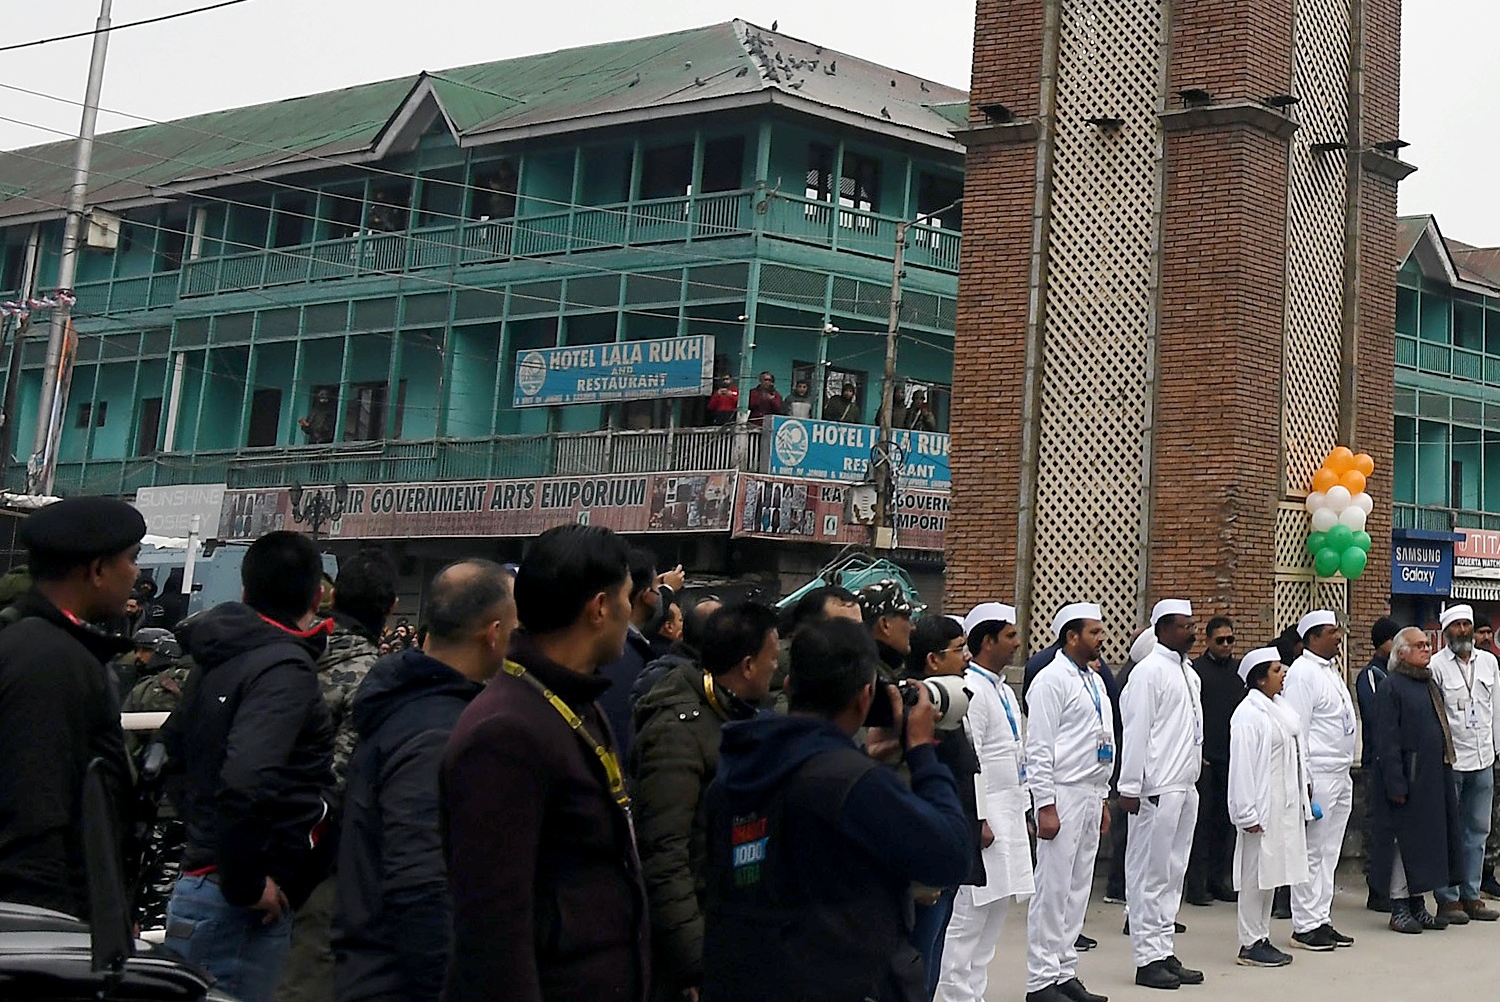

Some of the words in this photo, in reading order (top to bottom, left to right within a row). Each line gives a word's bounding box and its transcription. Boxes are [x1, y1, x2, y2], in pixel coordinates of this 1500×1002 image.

[550, 348, 596, 370] HOTEL
[602, 343, 643, 366] LALA
[649, 338, 701, 364] RUKH
[611, 366, 634, 376] AND
[578, 373, 668, 392] RESTAURANT
[812, 424, 864, 448] HOTEL
[870, 428, 912, 452] LLA
[140, 490, 220, 508] SUNSHINE
[370, 483, 488, 514] GOVERNMENT
[490, 481, 536, 512] ARTS
[540, 477, 647, 509] EMPORIUM
[1396, 546, 1440, 562] SAMSUNG
[1457, 557, 1482, 568] ROBERTA
[1482, 558, 1500, 568] WATCH
[1402, 566, 1435, 586] Galaxy
[734, 843, 762, 867] JODO
